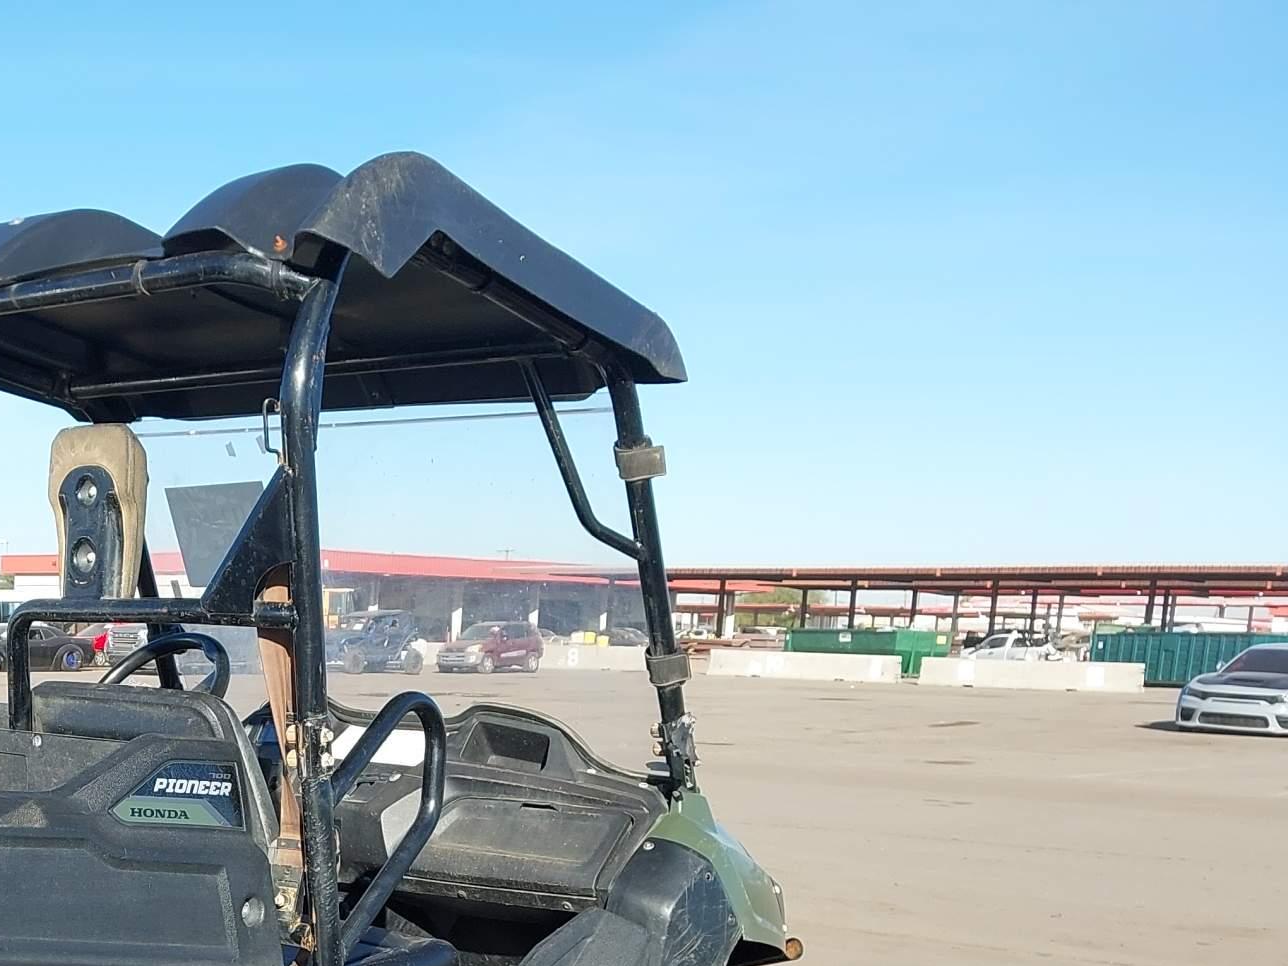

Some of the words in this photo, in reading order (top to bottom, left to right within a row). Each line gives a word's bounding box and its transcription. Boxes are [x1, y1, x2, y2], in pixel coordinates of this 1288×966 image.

[209, 771, 231, 781] 700
[153, 777, 233, 797] PIONEER
[129, 807, 190, 820] HONDA
